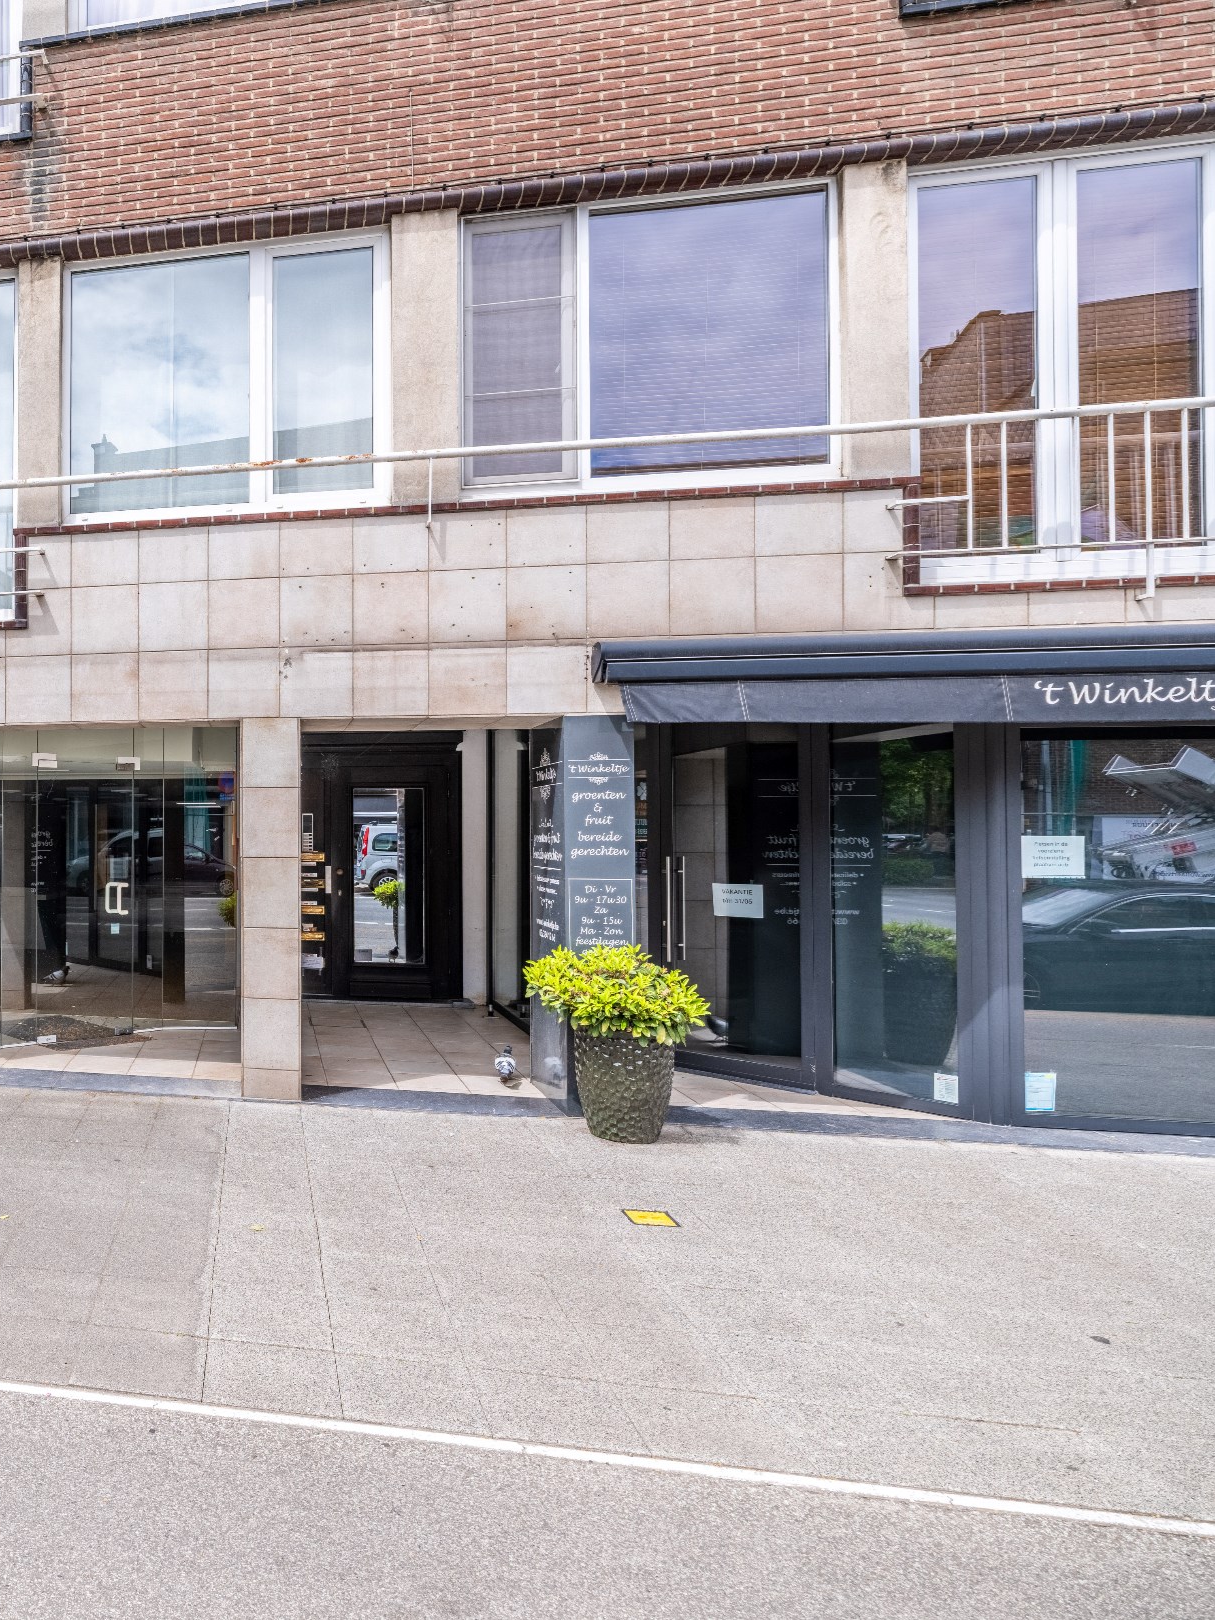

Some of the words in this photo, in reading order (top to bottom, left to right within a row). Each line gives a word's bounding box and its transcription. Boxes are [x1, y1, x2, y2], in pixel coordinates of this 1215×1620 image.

[1034, 680, 1065, 705] 't
[1068, 677, 1215, 711] Winkelt
[578, 764, 630, 775] Winkeltje
[571, 790, 627, 803] groenten
[593, 802, 603, 813] &
[585, 814, 614, 826] fruit
[577, 830, 623, 842] bereide
[570, 845, 630, 859] gerechten
[585, 885, 597, 893] Di
[605, 885, 617, 893] Vr
[721, 888, 753, 896] VAKANTIE
[574, 896, 588, 904] 9u
[596, 896, 627, 904] 17u30
[593, 906, 609, 914] Za
[581, 916, 596, 925] 9u
[603, 916, 623, 925] 15u
[580, 926, 597, 935] Ma
[604, 926, 624, 935] Zon
[575, 936, 629, 947] feestdagen
